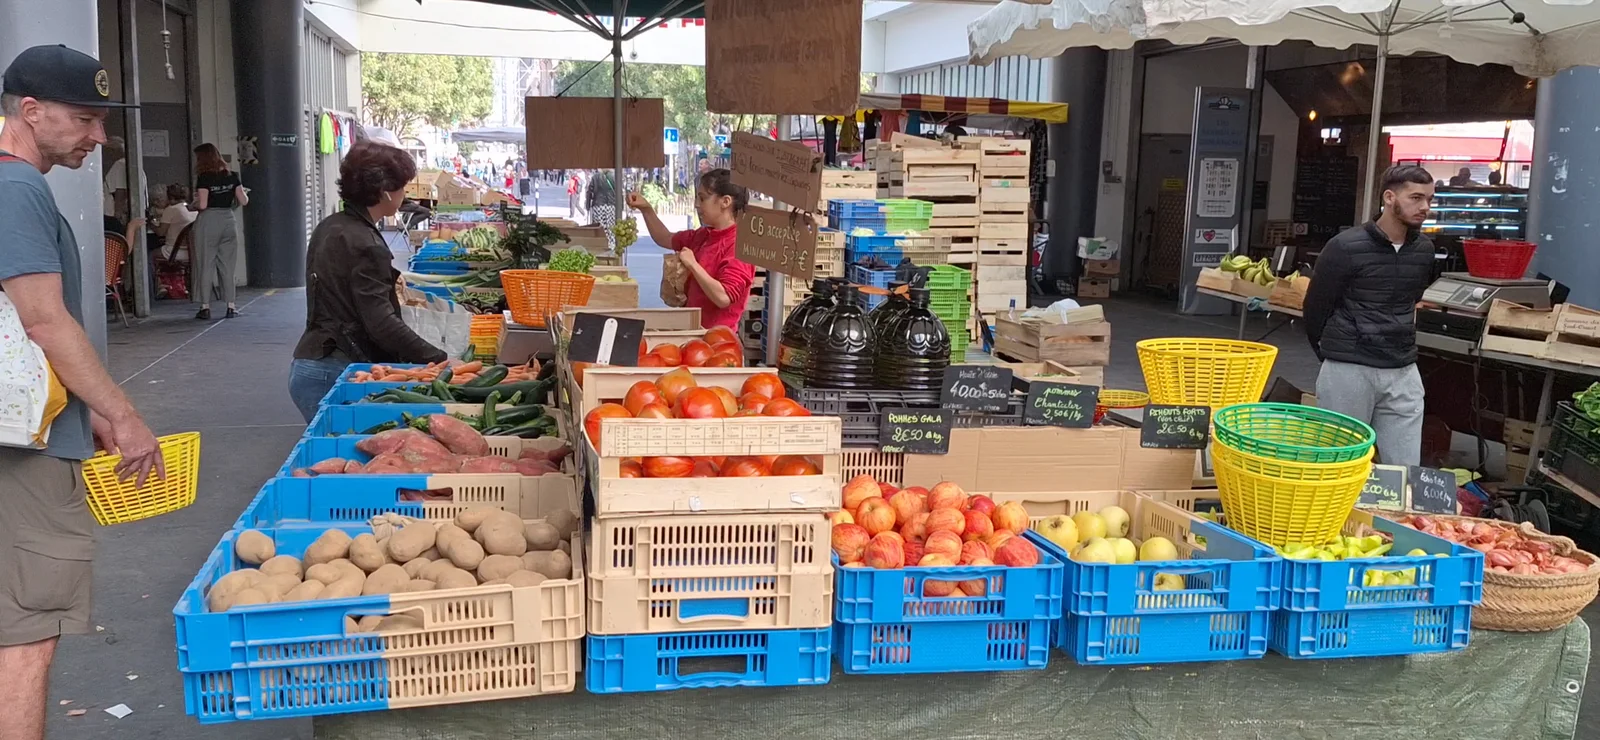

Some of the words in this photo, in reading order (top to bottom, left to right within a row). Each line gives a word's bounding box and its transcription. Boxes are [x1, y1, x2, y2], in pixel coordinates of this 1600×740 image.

[750, 215, 765, 236] CB
[743, 243, 777, 261] MINIMUM
[920, 414, 942, 423] GALA
